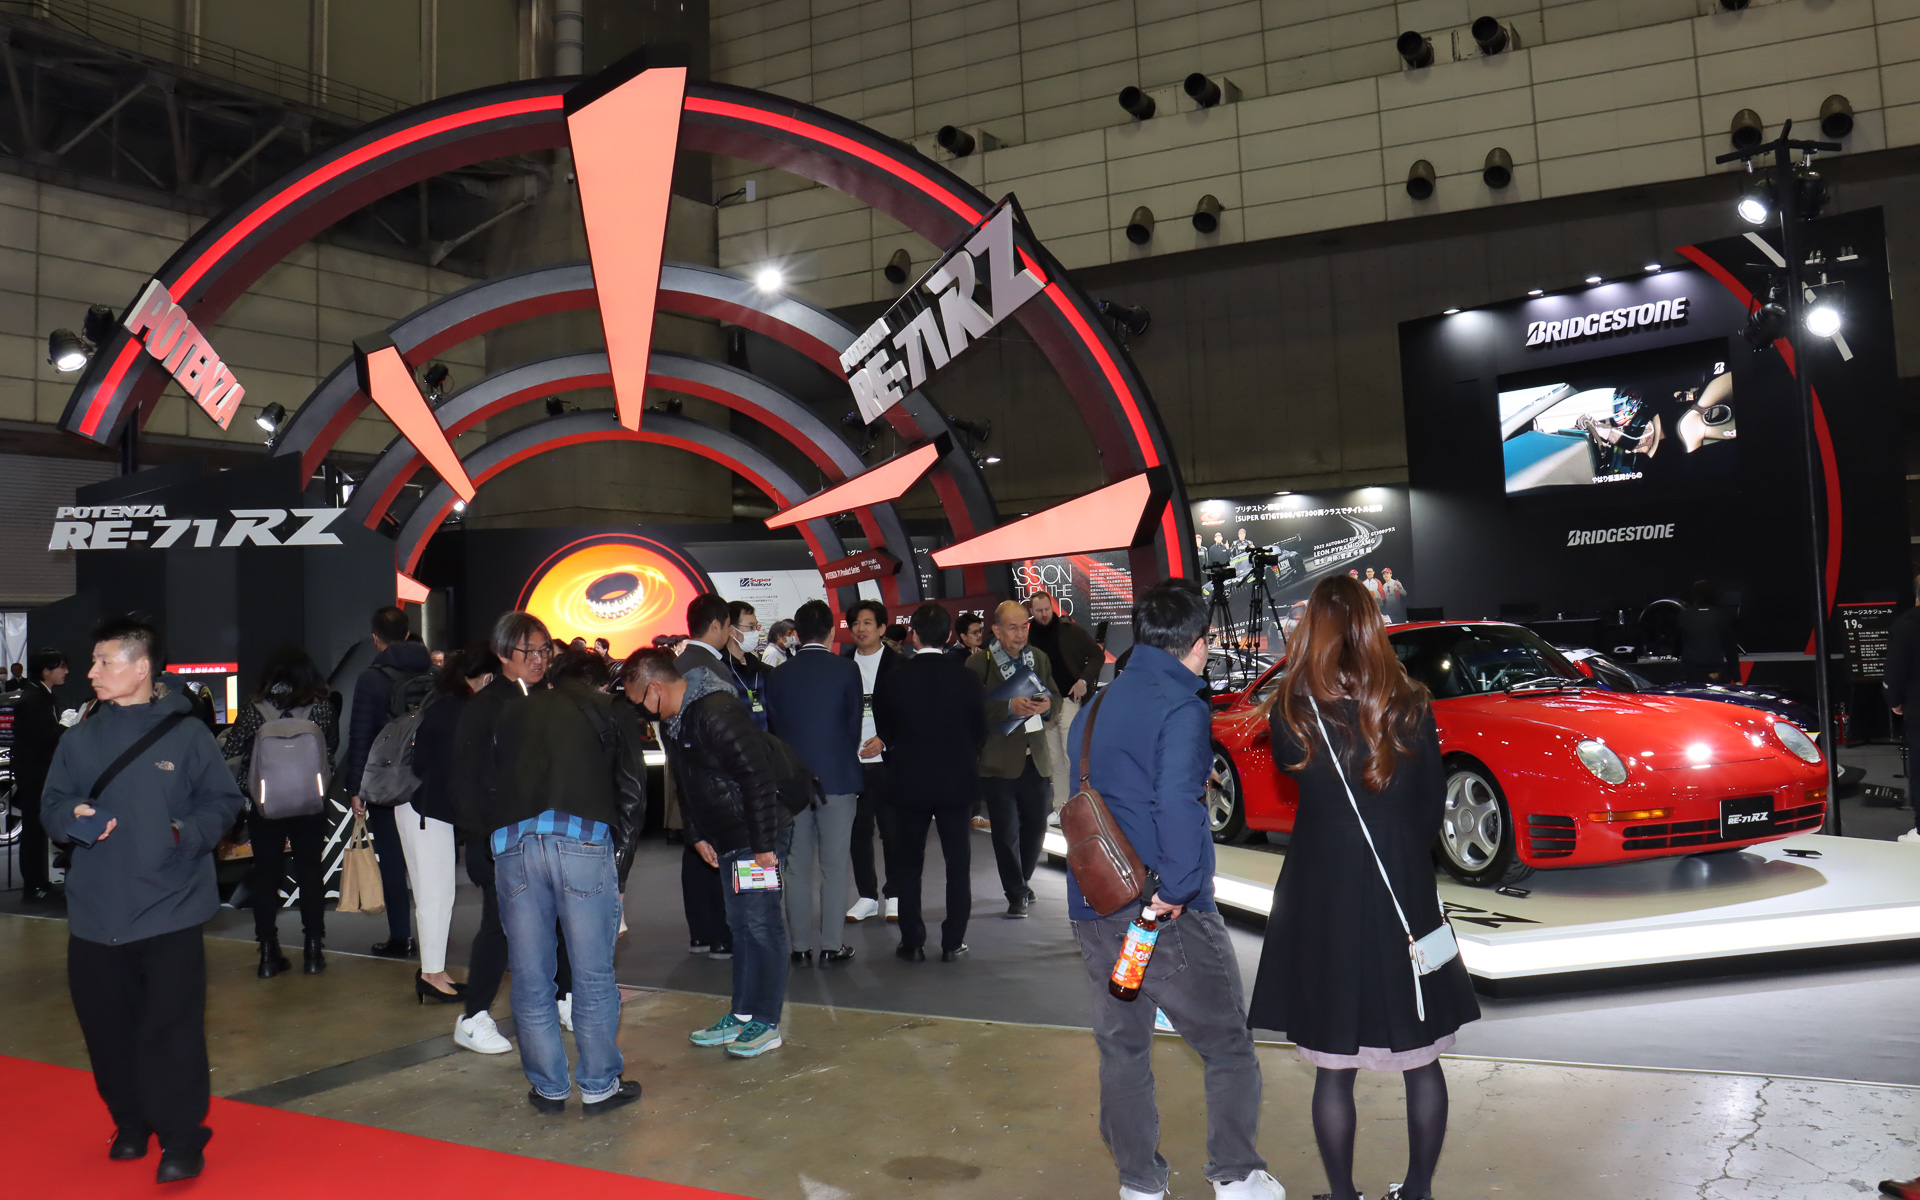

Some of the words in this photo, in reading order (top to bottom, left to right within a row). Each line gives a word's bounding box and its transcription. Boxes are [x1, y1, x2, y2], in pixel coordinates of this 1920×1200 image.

[1525, 297, 1687, 347] BRIDGESTONE
[124, 278, 246, 431] POTENZA
[56, 505, 167, 518] POTENZA
[48, 508, 347, 551] RE-71RZ
[1566, 523, 1676, 547] BRIDGESTONE
[1313, 549, 1330, 558] LEON
[1047, 584, 1073, 598] THE
